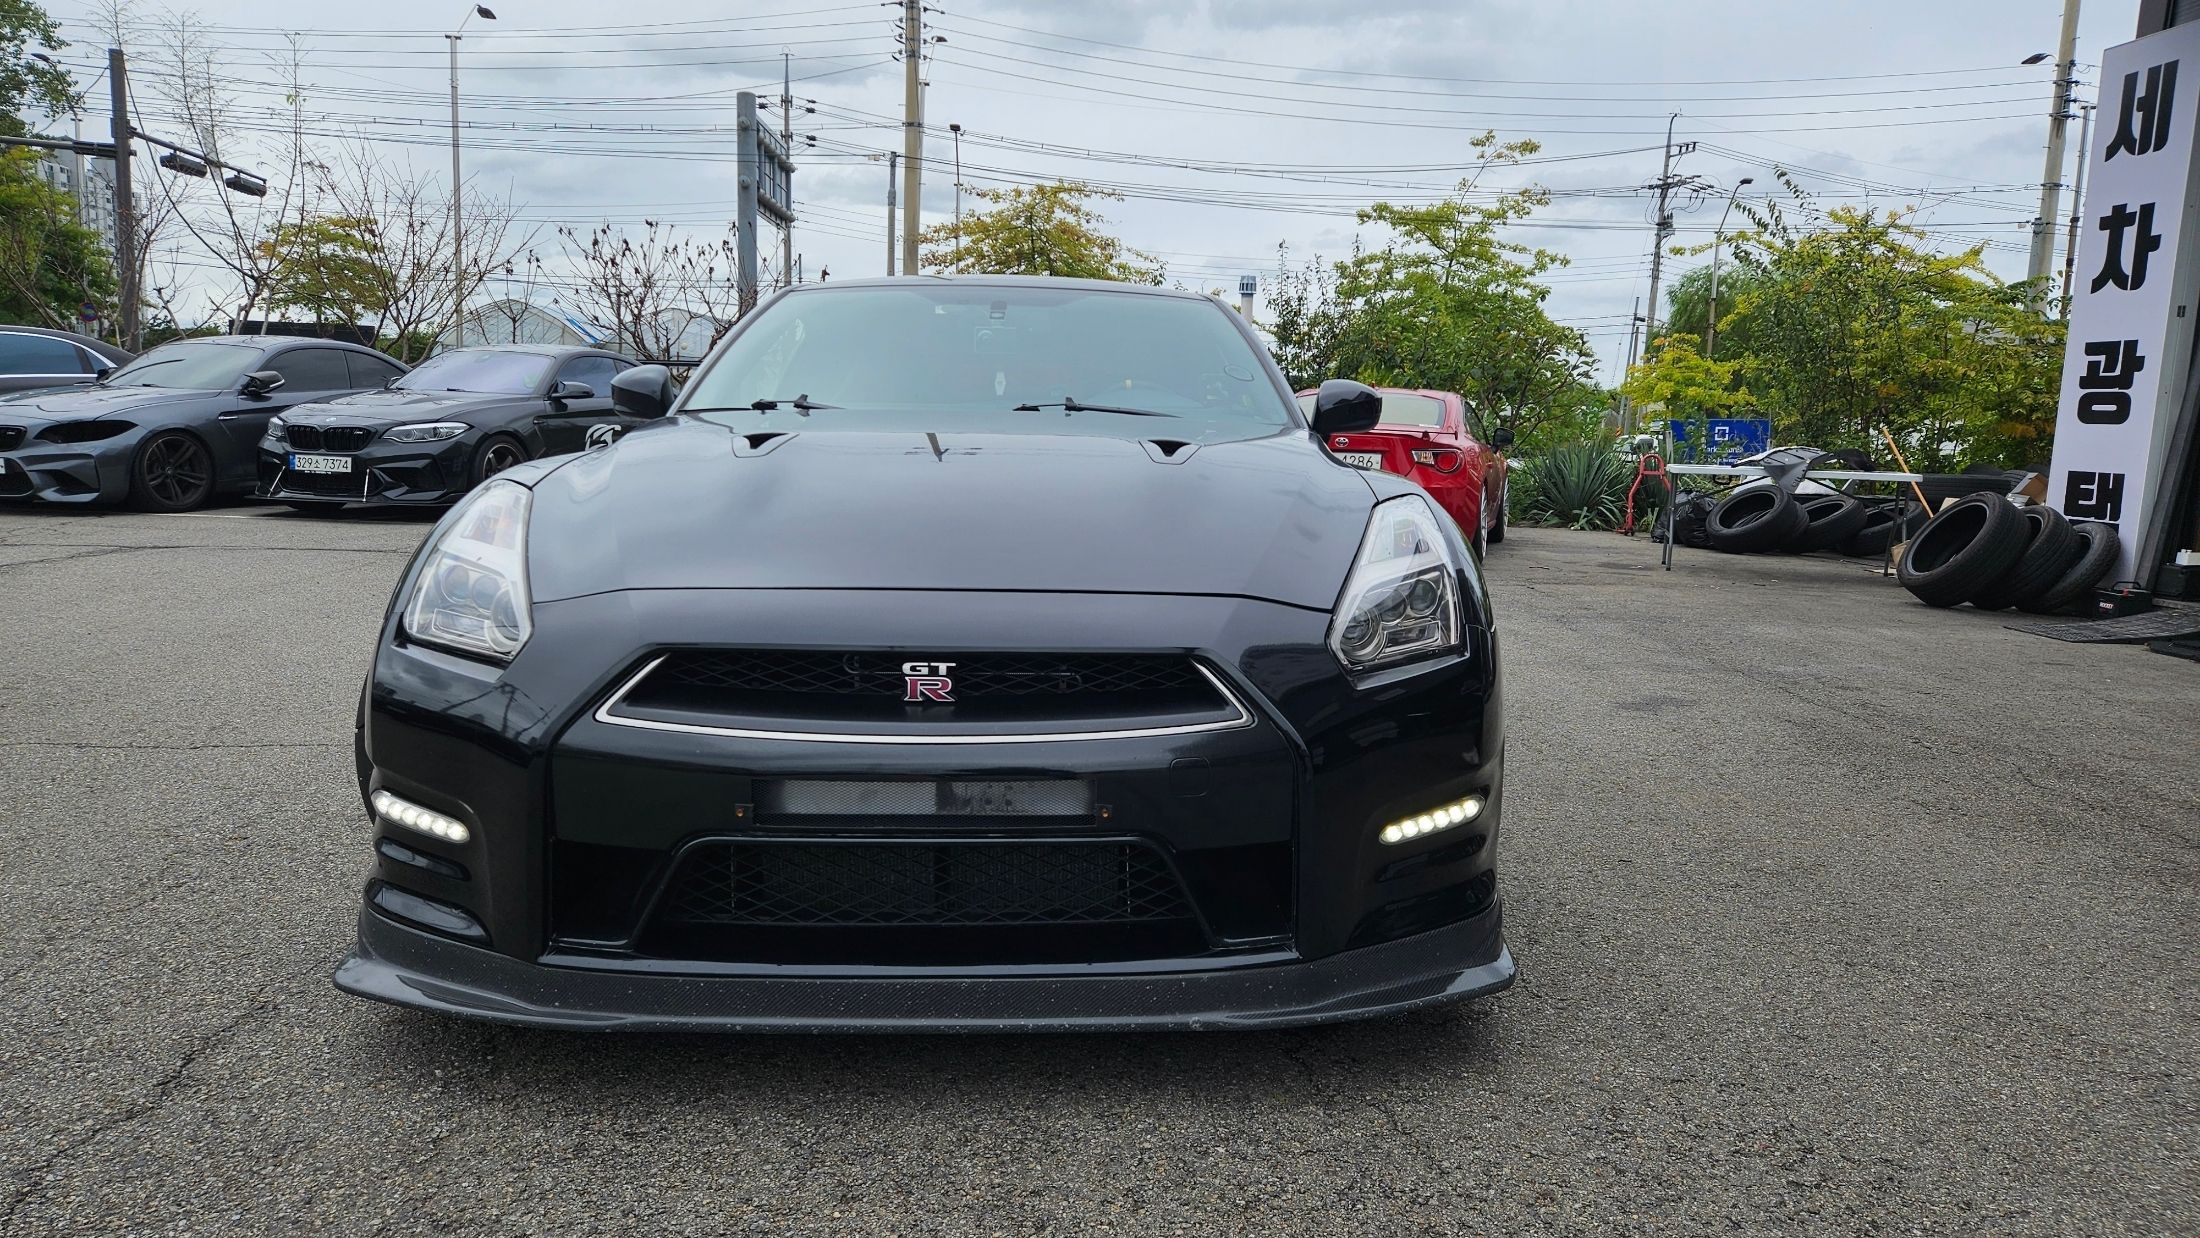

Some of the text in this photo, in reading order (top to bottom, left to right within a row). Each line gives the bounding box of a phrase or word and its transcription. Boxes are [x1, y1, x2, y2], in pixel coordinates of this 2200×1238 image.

[323, 458, 348, 470] 7374
[902, 662, 956, 675] GT
[904, 677, 955, 701] R
